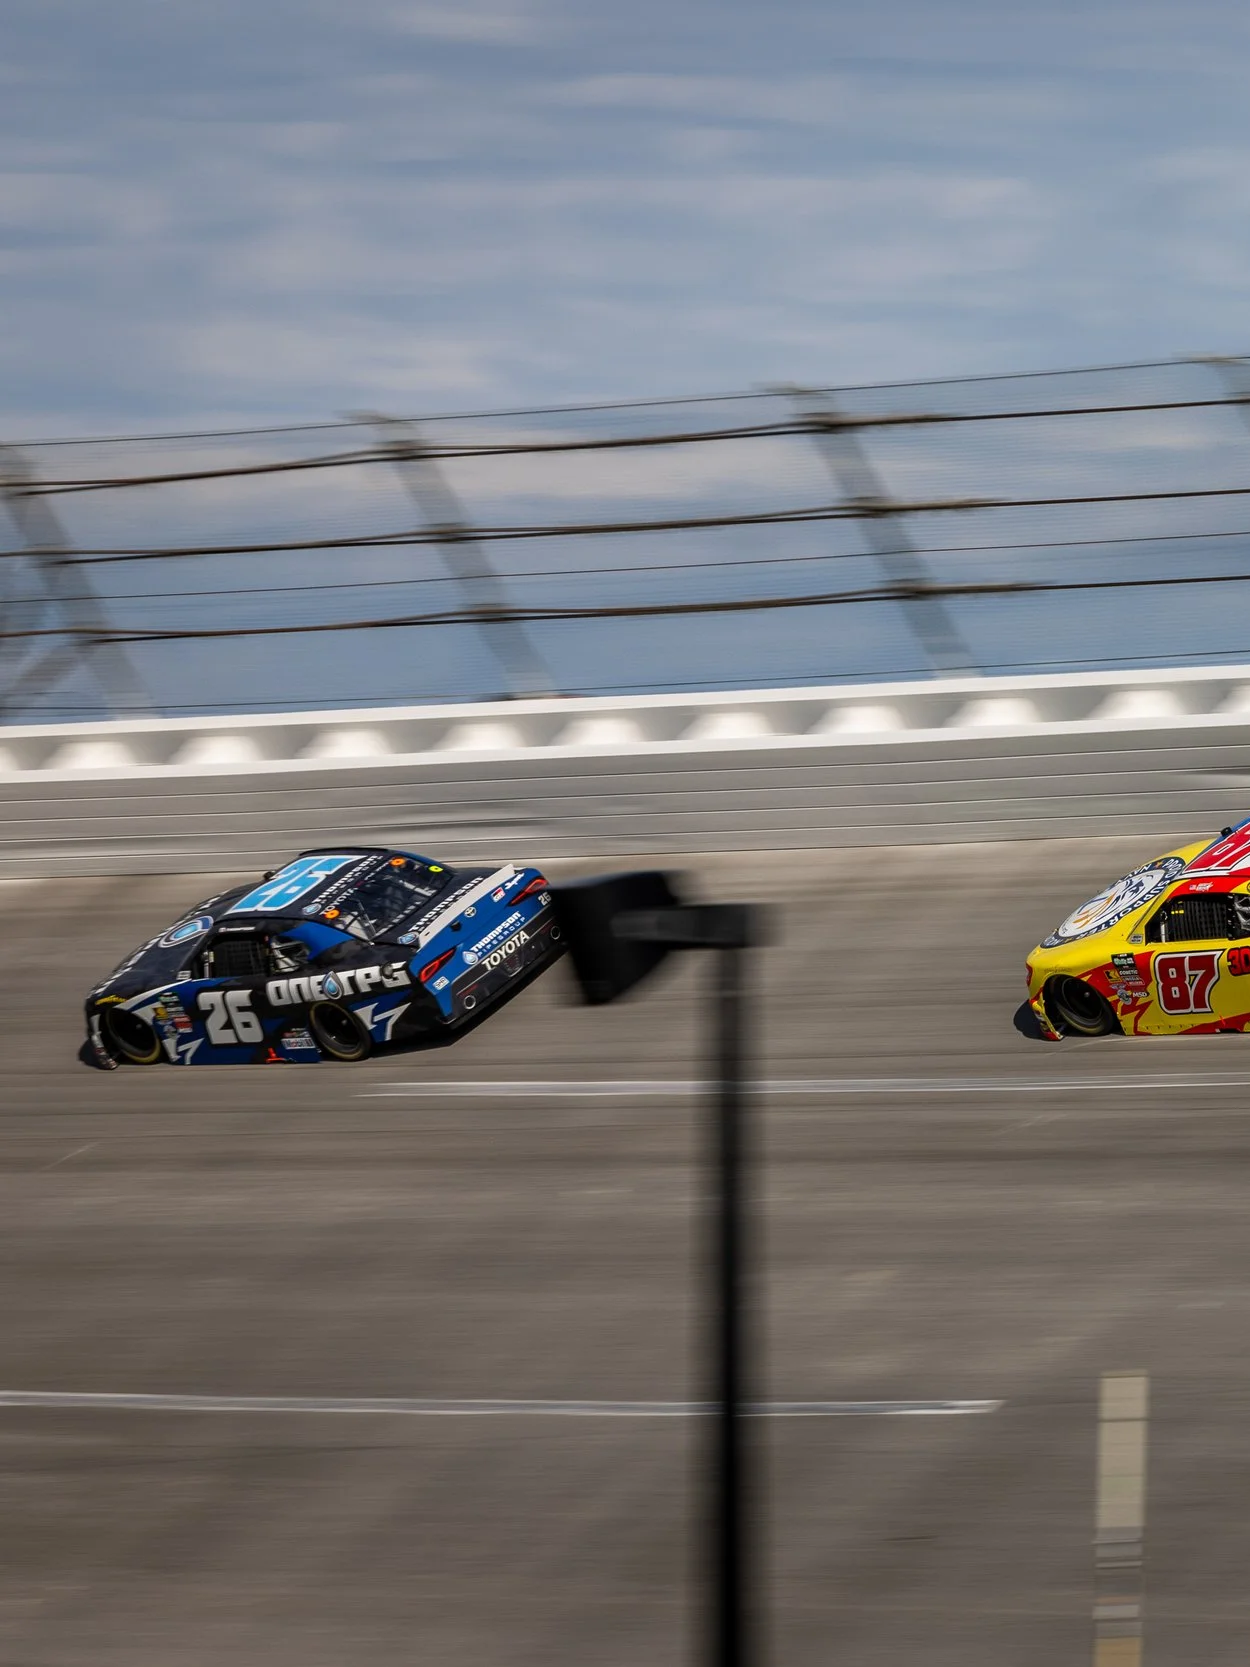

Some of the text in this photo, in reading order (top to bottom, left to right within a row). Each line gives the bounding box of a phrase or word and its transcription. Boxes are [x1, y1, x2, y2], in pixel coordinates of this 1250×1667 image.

[407, 876, 484, 932] THOMPSON
[537, 891, 552, 906] 26
[1076, 880, 1170, 940] SUPPORTER
[469, 910, 522, 953] THOMPSON
[481, 930, 531, 971] TOYOTA
[1154, 950, 1225, 1015] 87
[196, 989, 265, 1046] 26
